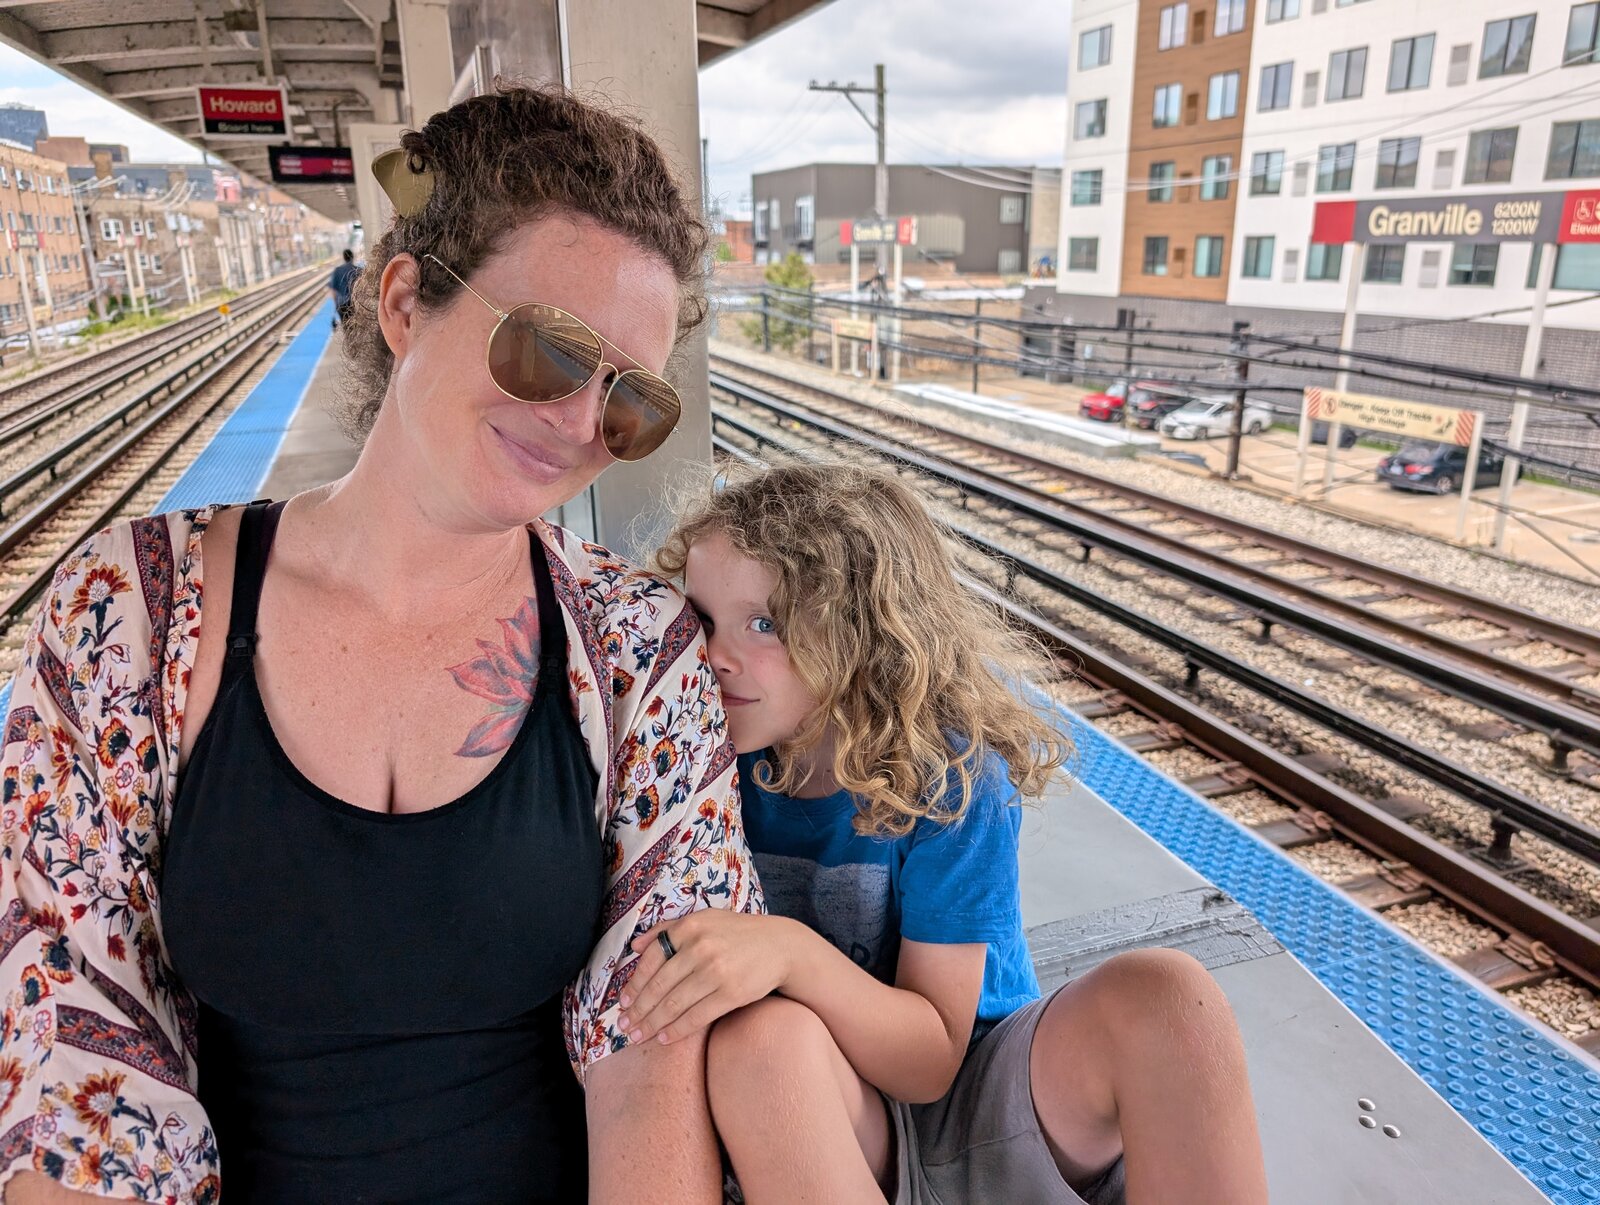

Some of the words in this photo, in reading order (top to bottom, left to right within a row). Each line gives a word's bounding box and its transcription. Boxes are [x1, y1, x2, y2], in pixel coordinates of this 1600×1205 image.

[210, 96, 277, 114] Howard
[1494, 200, 1541, 218] 6200N
[1368, 203, 1483, 236] Granville
[1491, 218, 1539, 235] 1200W
